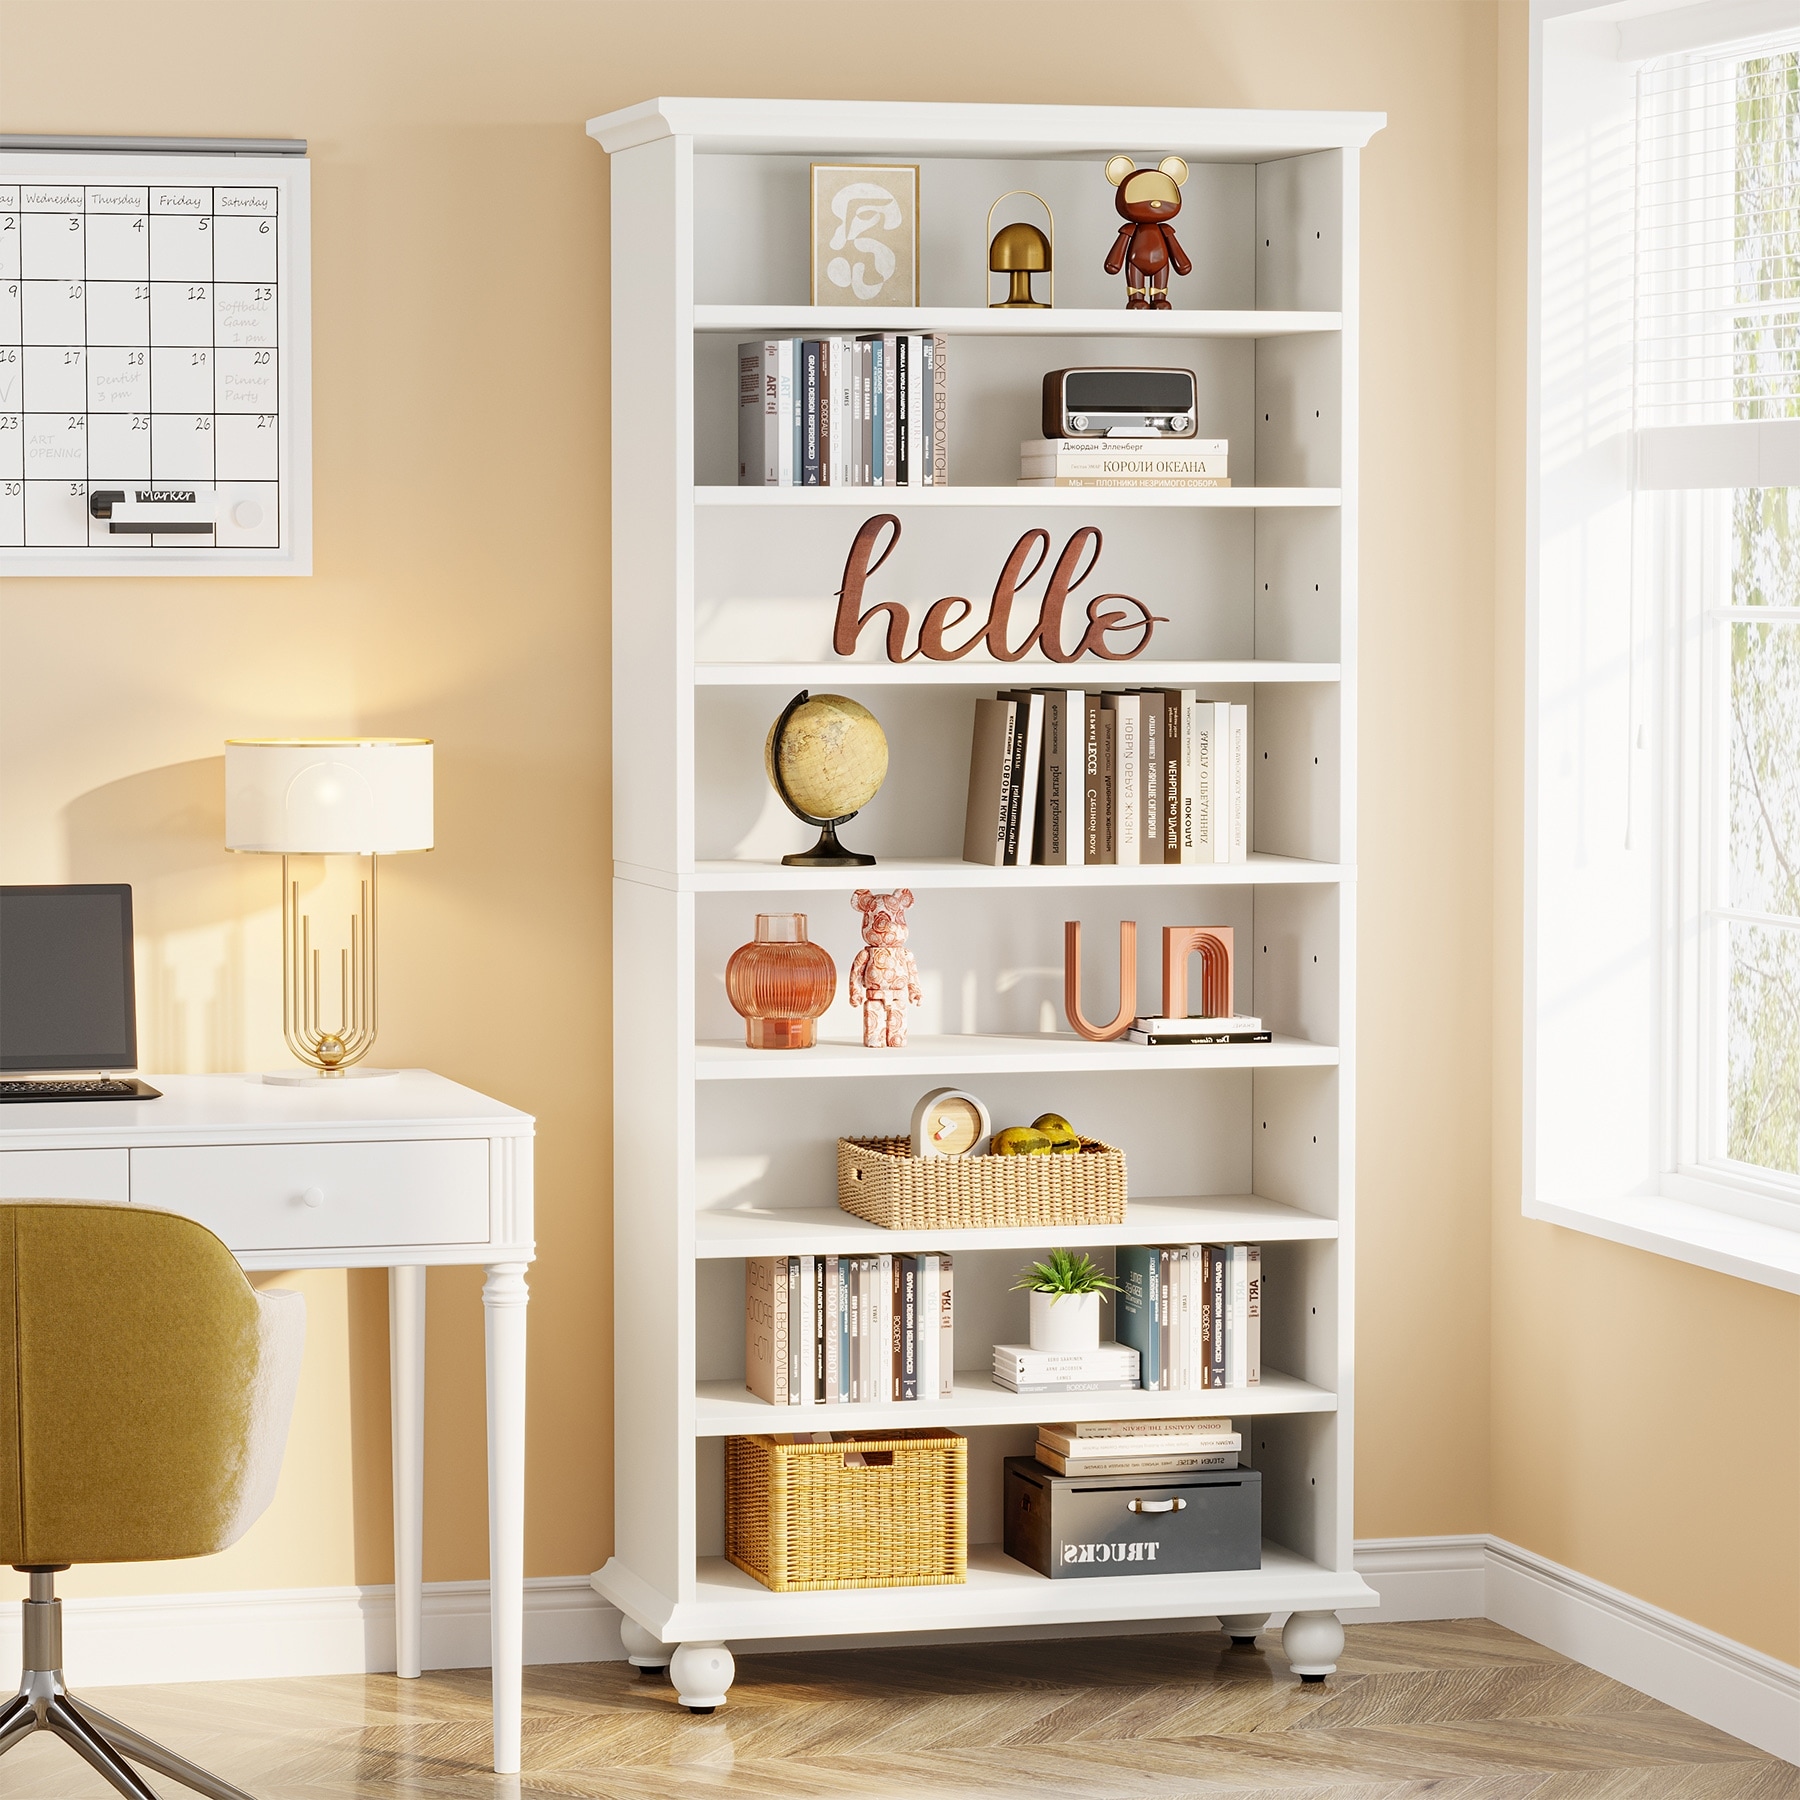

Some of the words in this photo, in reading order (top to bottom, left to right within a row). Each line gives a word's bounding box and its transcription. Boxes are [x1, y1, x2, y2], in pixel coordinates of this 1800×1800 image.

[26, 193, 82, 207] Wednesday
[92, 194, 141, 207] Thursday
[160, 195, 201, 209] Friday
[221, 196, 268, 210] Saturday
[4, 217, 16, 231] 2
[69, 218, 80, 231] 3
[132, 219, 144, 232] 4
[198, 217, 210, 231] 5
[259, 221, 270, 234] 6
[8, 285, 18, 298] 9
[69, 286, 82, 299] 10
[135, 287, 150, 300] 11
[188, 287, 206, 300] 12
[254, 288, 272, 301] 13
[218, 301, 268, 314] Softball
[223, 316, 259, 327] Game
[246, 335, 267, 344] pm
[0, 350, 16, 363] 16
[64, 352, 81, 365] 17
[128, 352, 145, 365] 18
[192, 353, 207, 365] 19
[254, 351, 271, 364] 20
[935, 337, 946, 386] ALEXEY
[96, 372, 141, 385] Dentist
[225, 374, 270, 385] Dinner
[886, 370, 894, 400] BOOK
[767, 375, 776, 398] ART
[781, 376, 790, 398] ART
[97, 392, 106, 402] 3
[111, 392, 132, 402] pm
[225, 390, 258, 403] Party
[0, 416, 19, 430] 23
[67, 416, 85, 430] 24
[131, 417, 150, 430] 25
[195, 417, 211, 431] 26
[257, 415, 275, 429] 27
[29, 435, 55, 445] ART
[886, 412, 894, 466] SYMBOLS
[935, 393, 946, 477] BRODOVITCH
[1063, 442, 1099, 451] Джордан
[1102, 443, 1142, 451] Элленберг
[29, 448, 82, 459] OPENING
[1103, 461, 1153, 472] КОРОЛИ
[1156, 461, 1206, 472] ОКЕАНА
[5, 483, 21, 496] 30
[70, 483, 85, 496] 31
[140, 490, 193, 501] Marker
[833, 513, 1171, 664] hello
[1066, 1383, 1099, 1391] BORDEAUX
